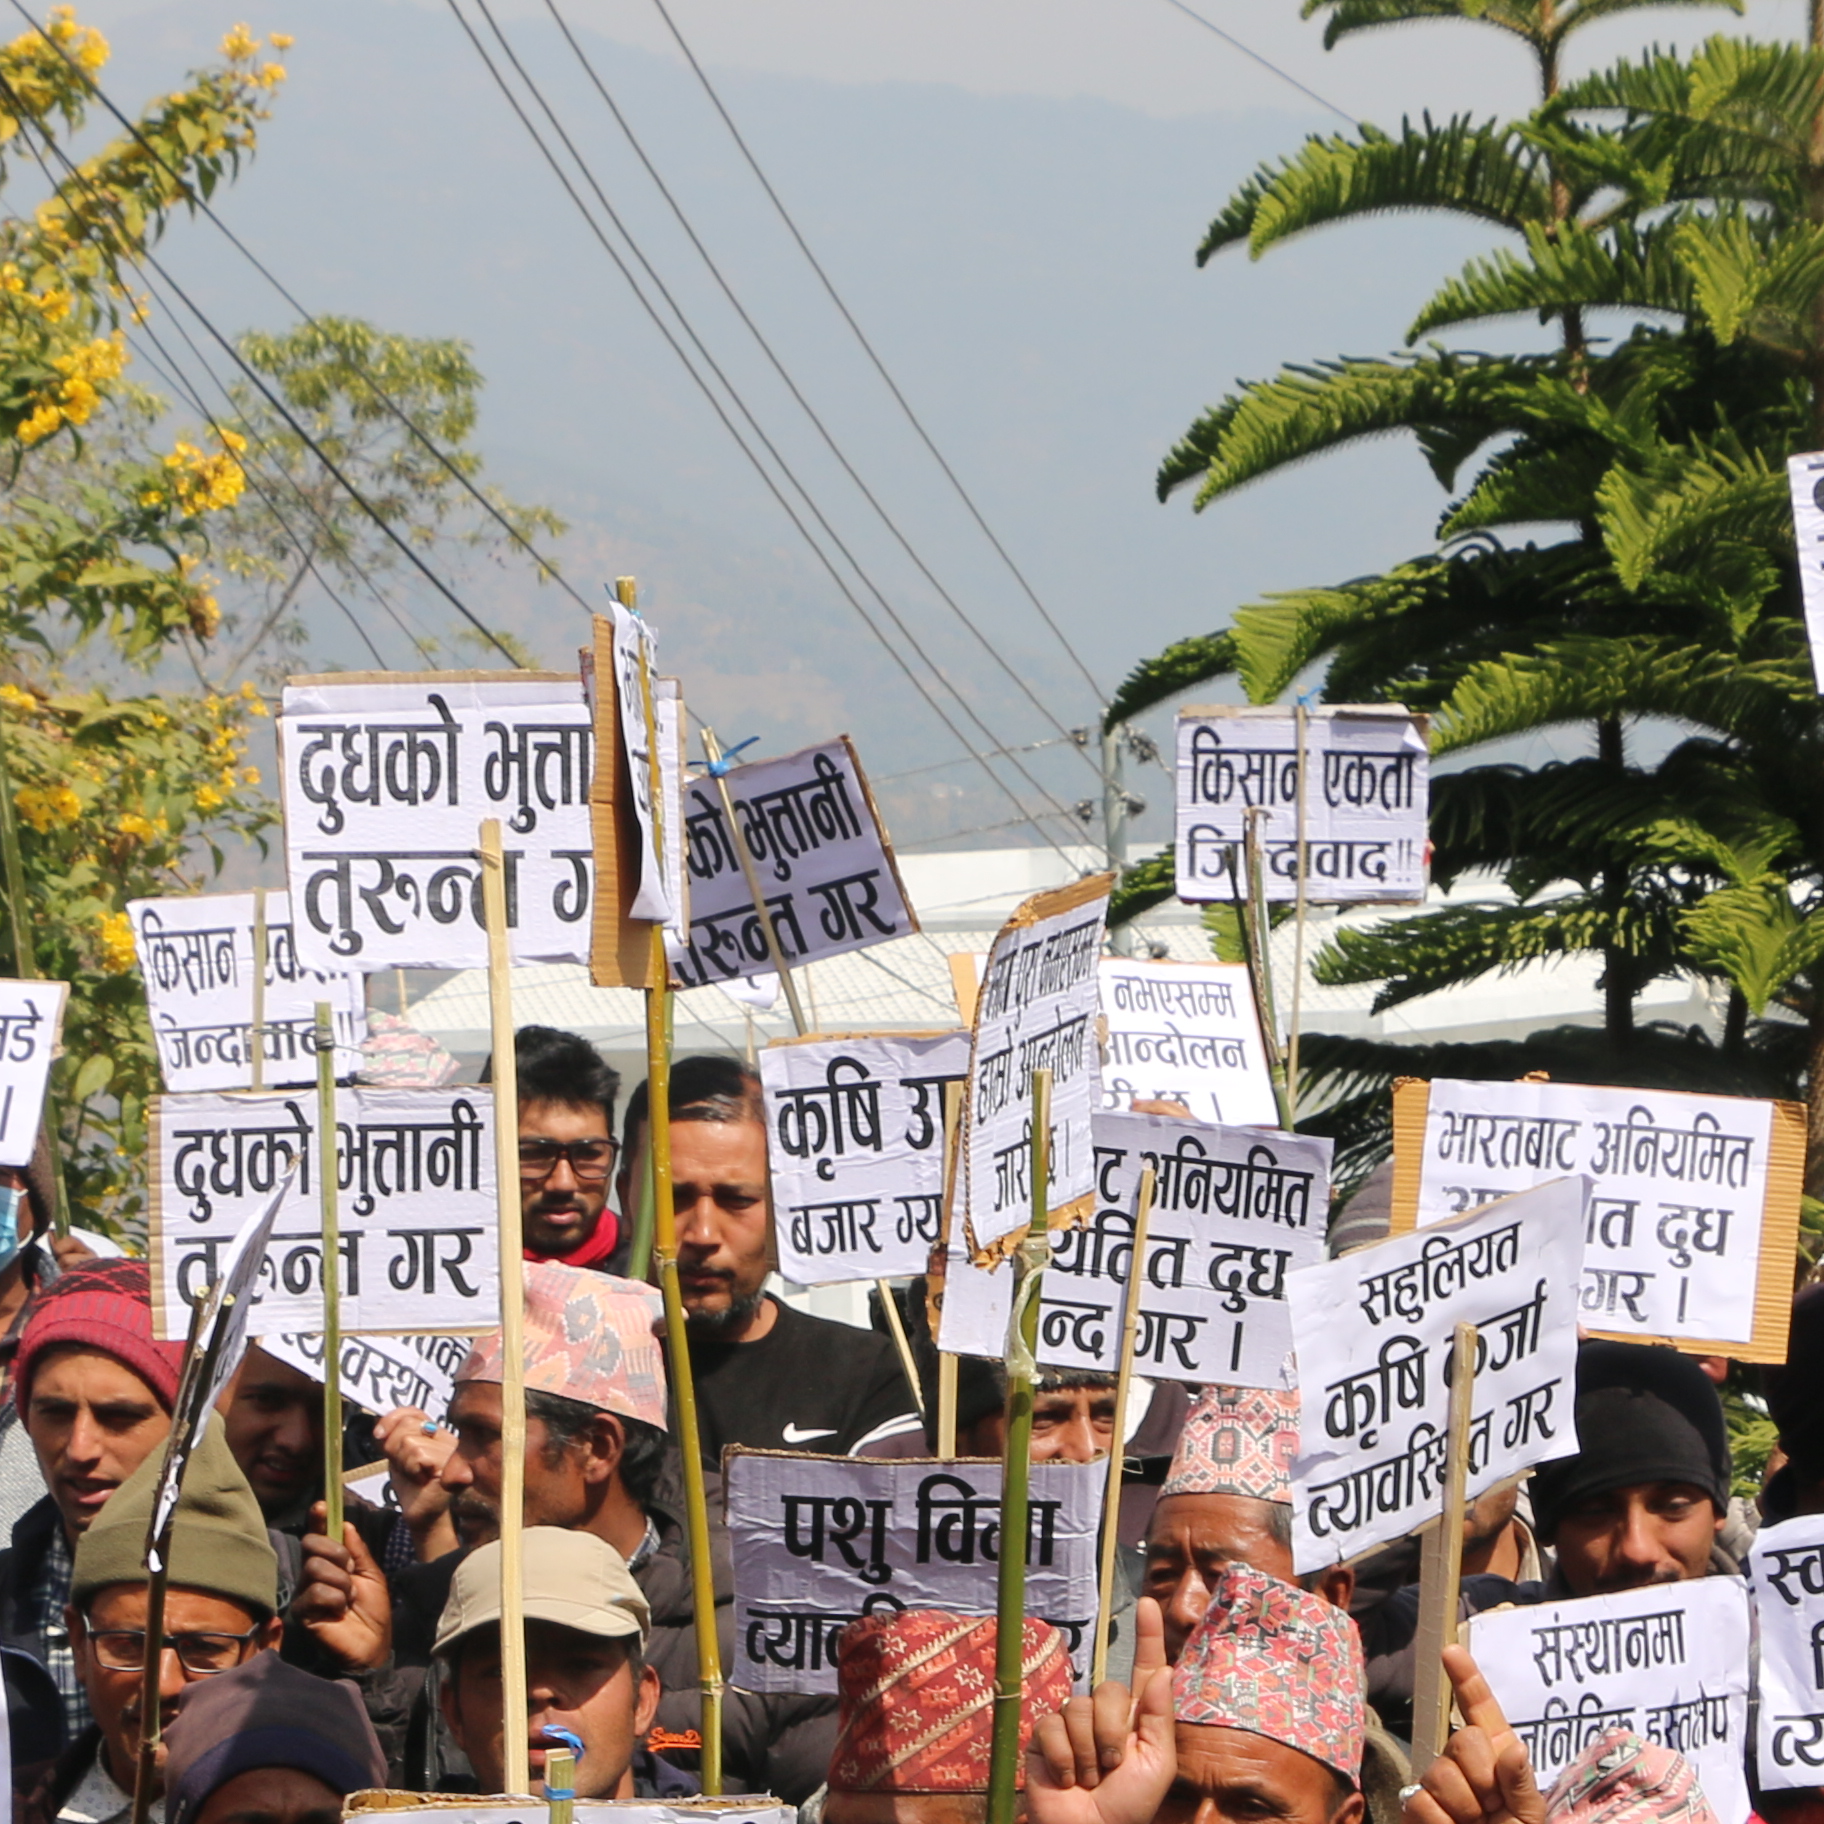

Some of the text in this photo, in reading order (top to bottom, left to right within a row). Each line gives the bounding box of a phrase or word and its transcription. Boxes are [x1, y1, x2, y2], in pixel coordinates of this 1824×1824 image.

[295, 694, 463, 835] दुधको
[484, 721, 593, 832] भुत्ता
[1192, 725, 1414, 814] किसान एकता
[808, 869, 896, 940] गर
[776, 1055, 882, 1182] कृषि
[1437, 1104, 1756, 1192] भारतबाट अनियमित
[389, 1228, 481, 1300] गर
[790, 1197, 882, 1256] बजार
[1655, 1202, 1735, 1268] दुध
[1359, 1219, 1524, 1326] सहुलियत
[1324, 1334, 1430, 1451] कृषि
[1504, 1378, 1563, 1447] गर
[780, 1494, 893, 1585] पशु
